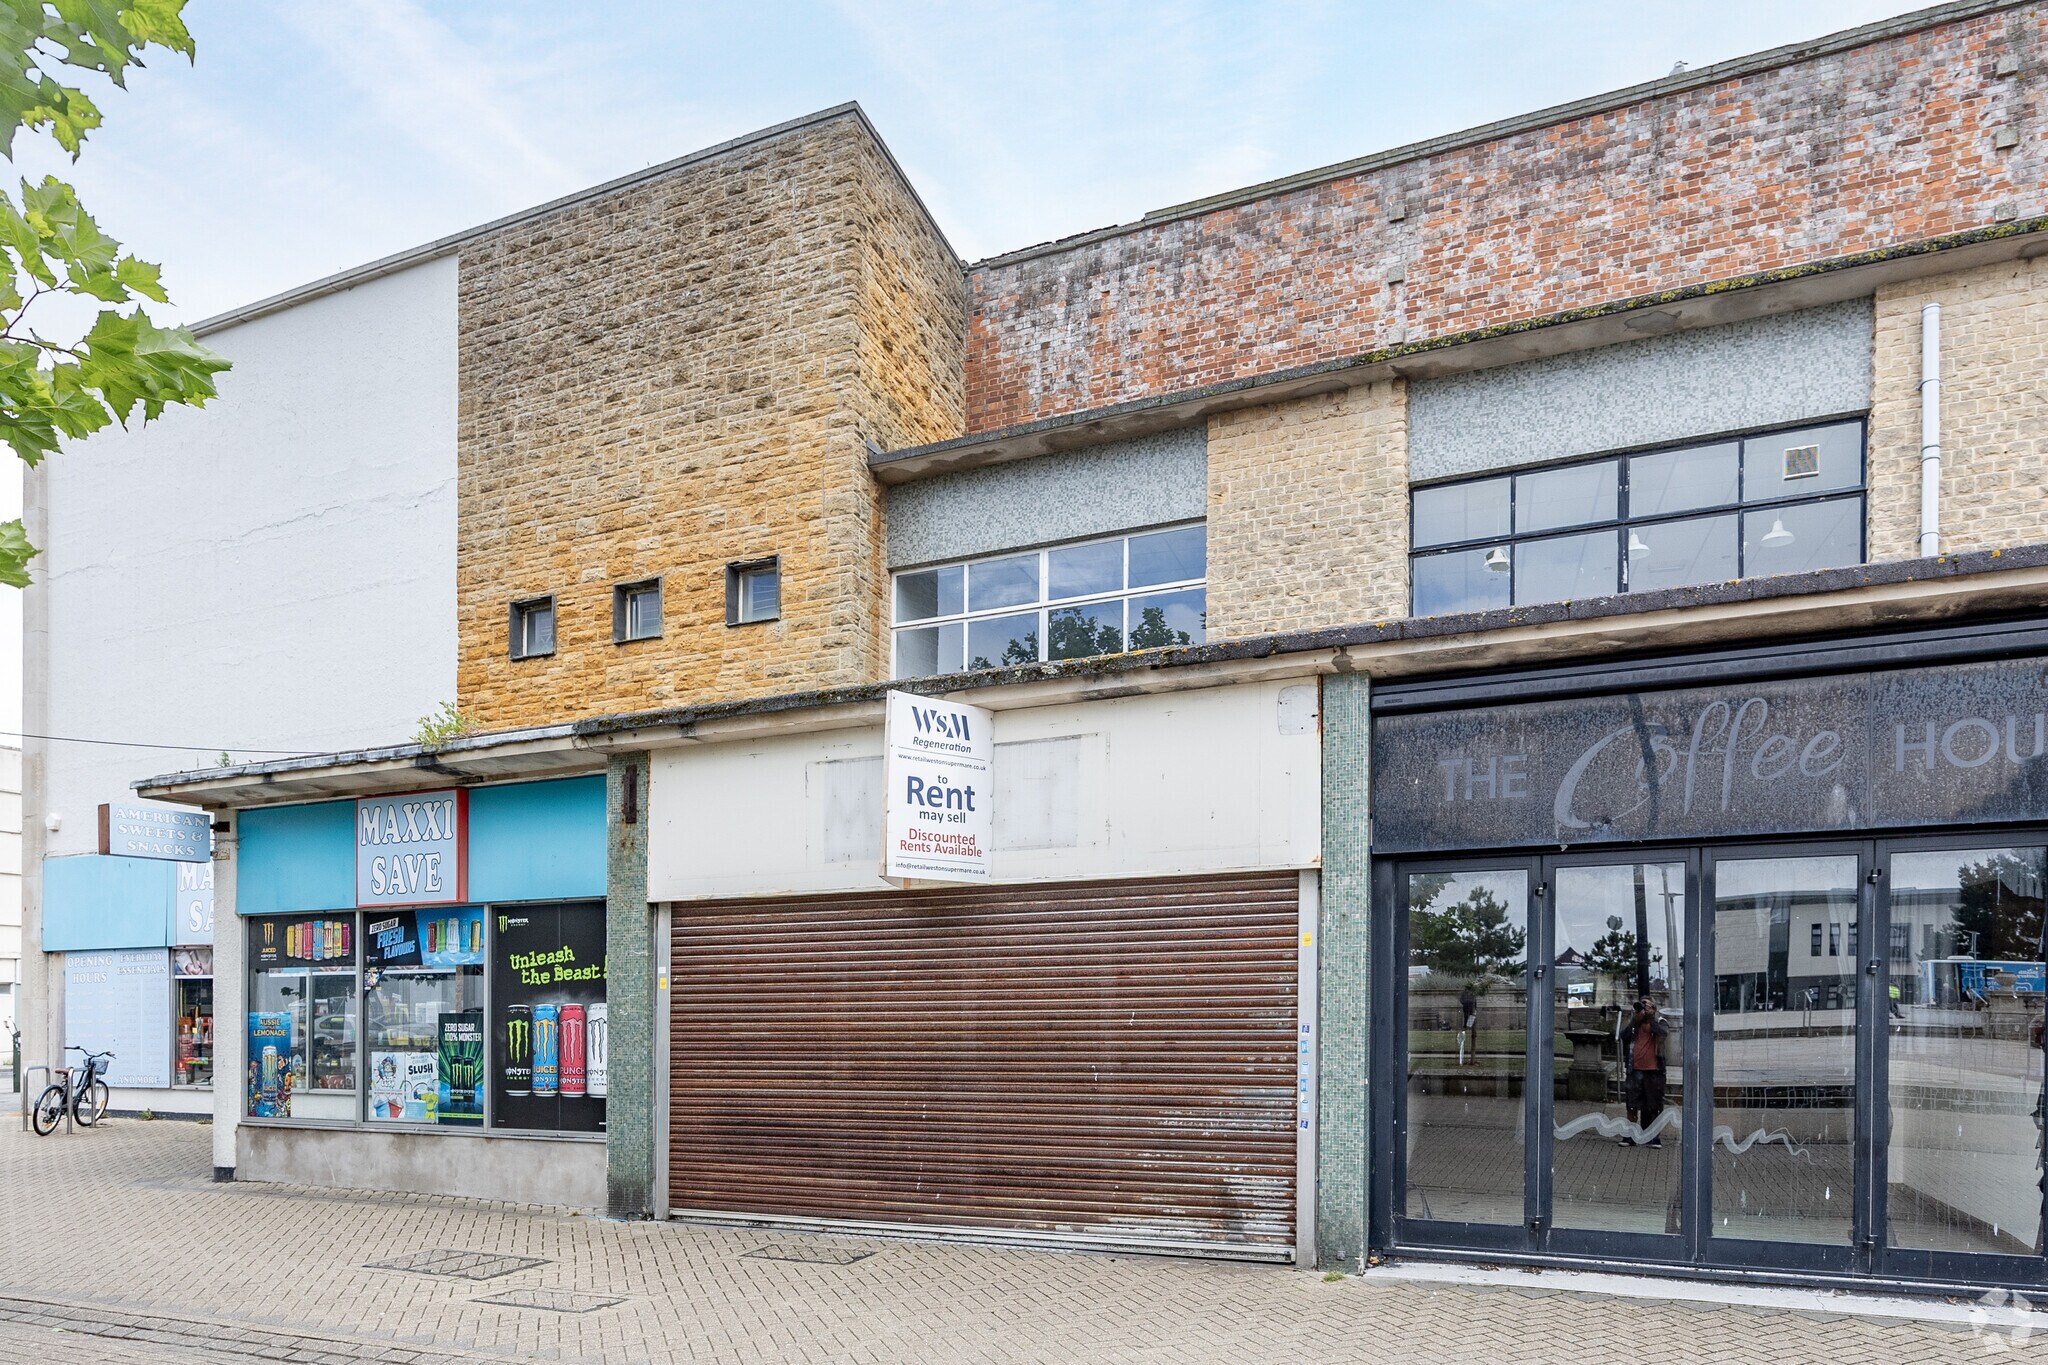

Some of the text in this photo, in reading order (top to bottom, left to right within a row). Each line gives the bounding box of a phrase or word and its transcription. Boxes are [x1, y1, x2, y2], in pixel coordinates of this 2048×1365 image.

[912, 736, 972, 754] Regeneration
[897, 753, 987, 771] www.retailwestonsupermare.co.uk
[1438, 754, 1528, 801] THE
[1553, 697, 1847, 829] Coffee
[937, 774, 948, 785] to
[906, 775, 976, 812] Rent
[115, 807, 205, 828] AMERICAN
[360, 799, 454, 847] MAXXI
[919, 810, 966, 824] may sell
[118, 824, 204, 843] SWEETS &
[908, 827, 976, 846] Discounted
[126, 840, 196, 857] SNACKS
[899, 839, 983, 858] Rents Available
[370, 851, 443, 896] SAVE
[895, 861, 986, 876] info@retailwestonsupermare.co.uk
[371, 919, 397, 933] ZERO SUGAR
[377, 926, 405, 949] FRESH
[119, 951, 164, 963] EVERYDAY
[384, 940, 416, 960] FLAVOURS
[509, 945, 576, 970] Unleash
[67, 954, 113, 968] OPENING
[117, 964, 168, 976] ESSENTIALS
[521, 968, 551, 985] the
[72, 971, 108, 985] HOURS
[259, 1017, 281, 1026] AUSSIE
[444, 1023, 475, 1032] ZERO SUGAR
[253, 1029, 287, 1037] LEMONADE
[444, 1032, 482, 1042] 100% MONSTER
[408, 1063, 433, 1075] SLUSH
[505, 1067, 531, 1076] MONSTE
[560, 1066, 585, 1075] PUNCH
[118, 1074, 135, 1085] AND
